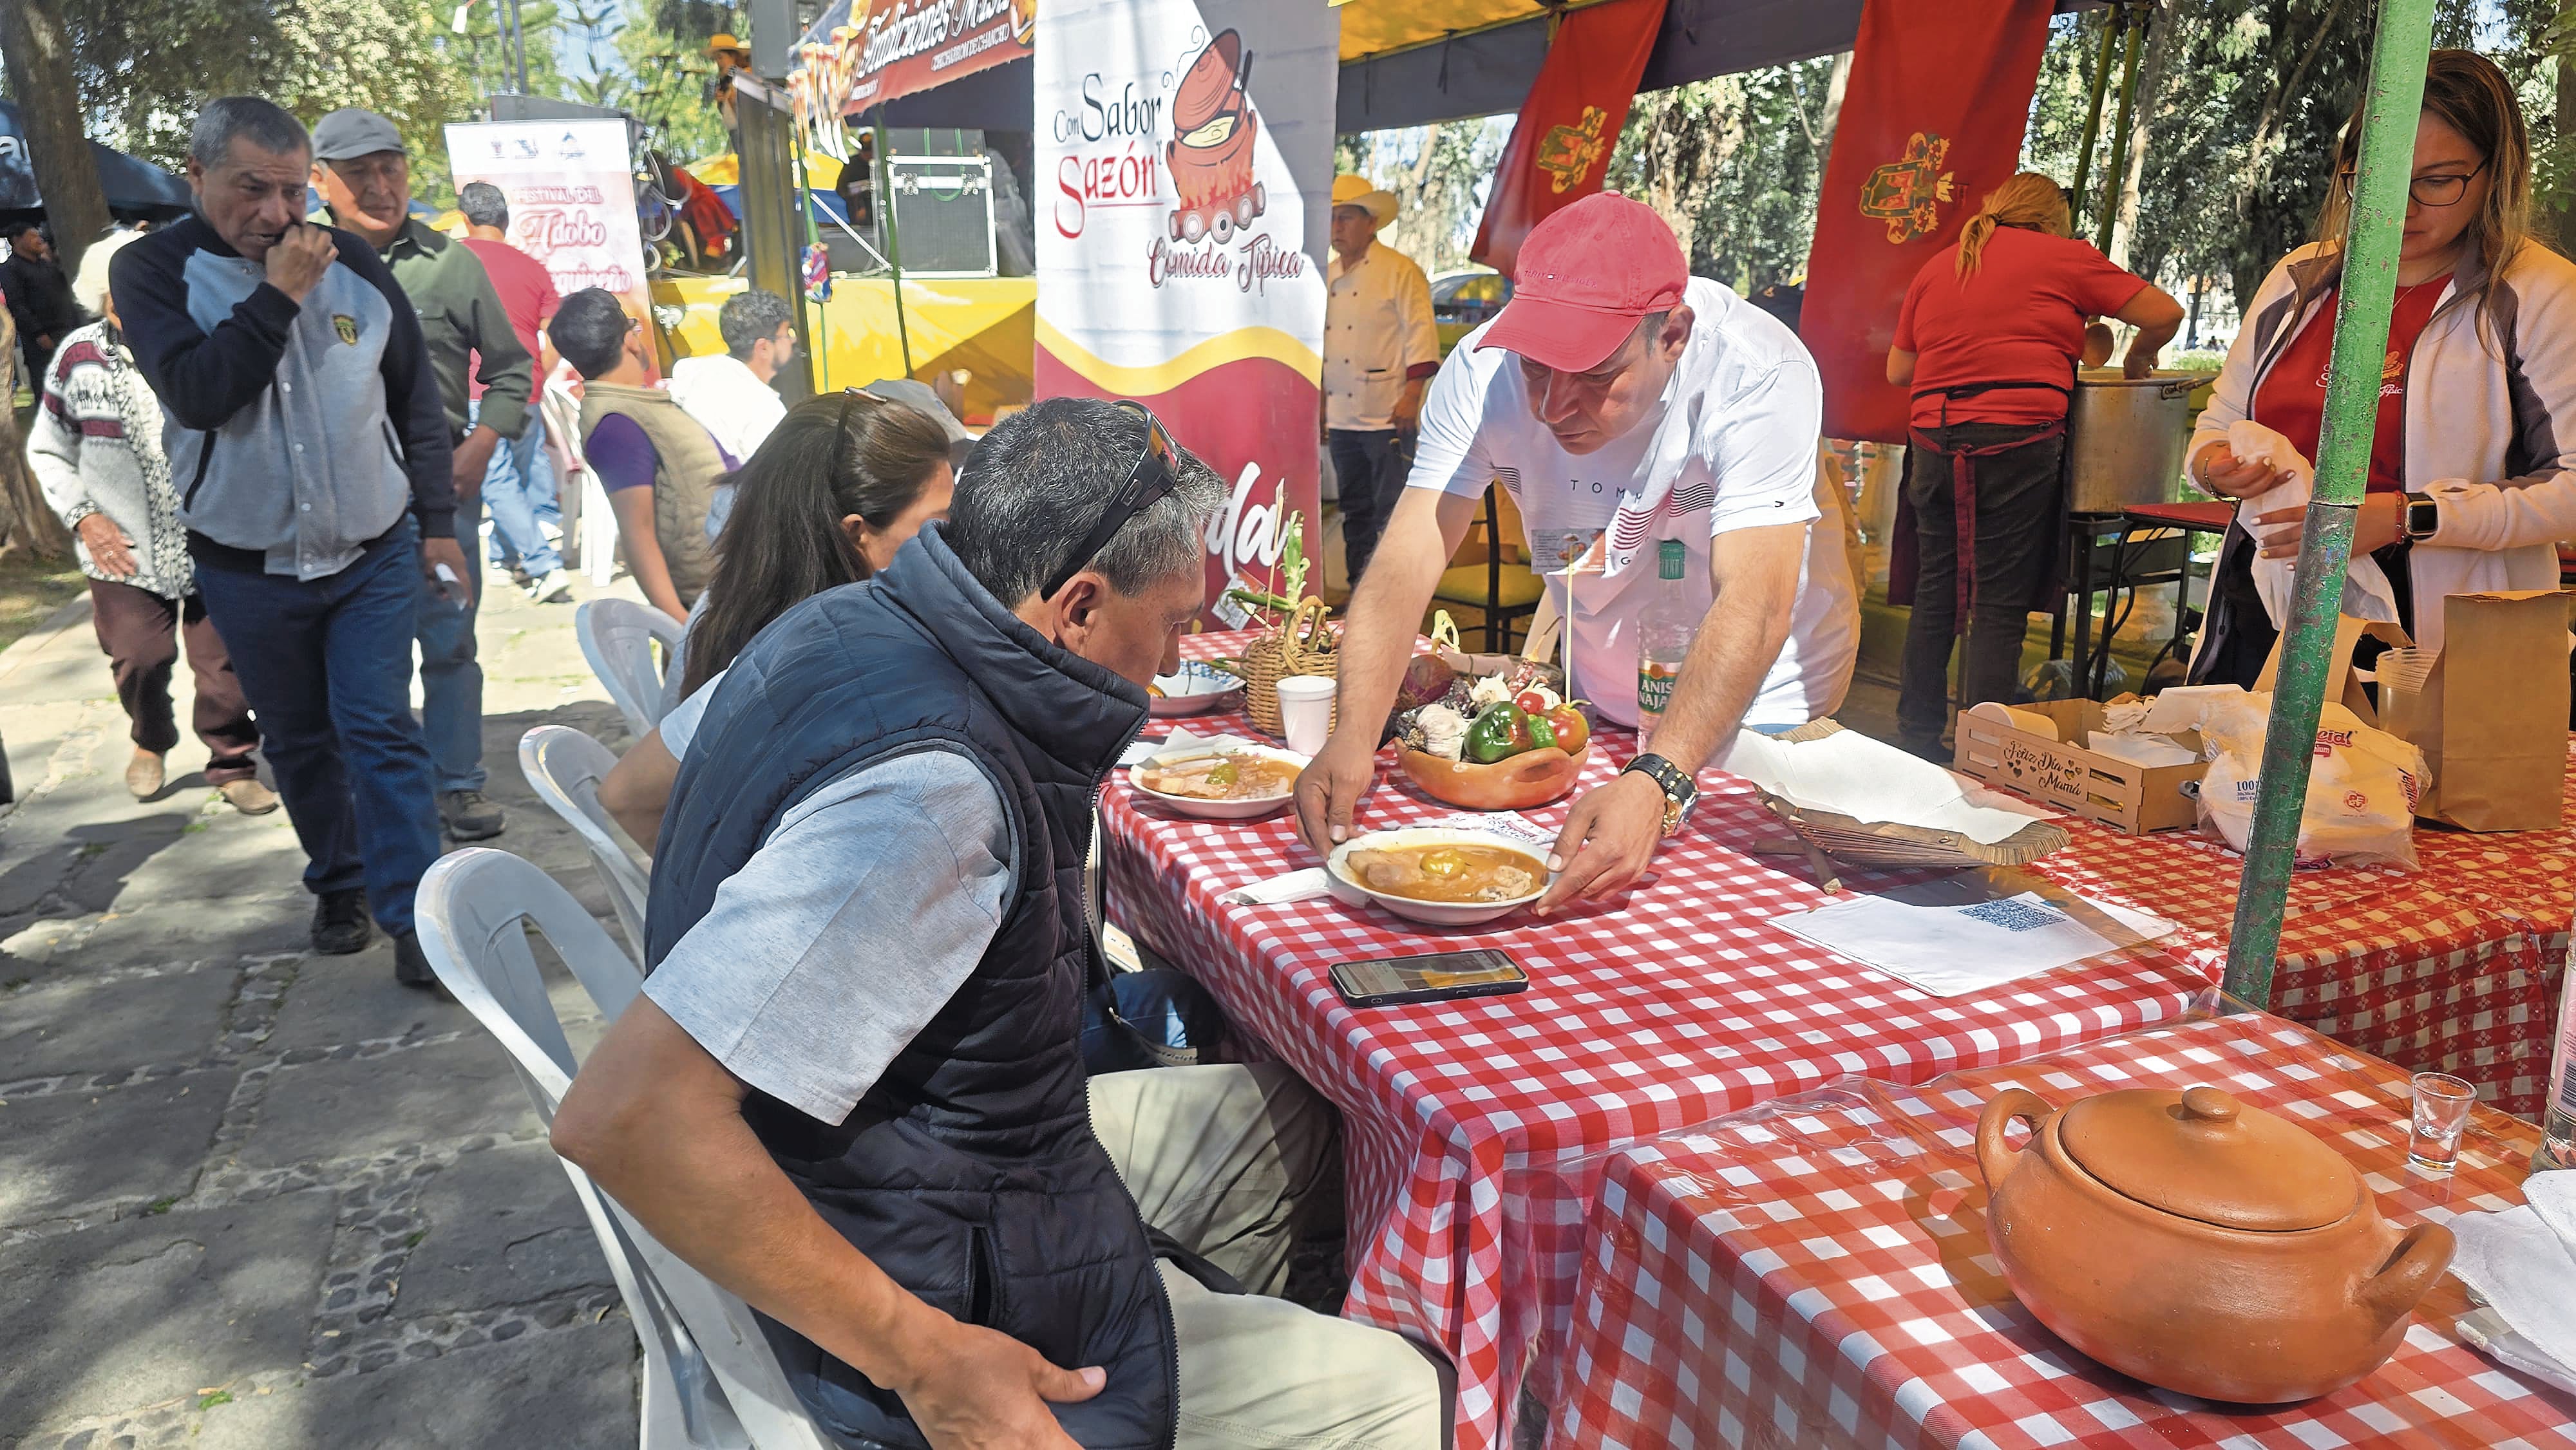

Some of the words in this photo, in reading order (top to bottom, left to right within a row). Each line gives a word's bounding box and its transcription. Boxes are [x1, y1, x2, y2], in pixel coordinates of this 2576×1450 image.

[1054, 109, 1079, 143] Con
[1081, 73, 1161, 142] Sabor
[575, 185, 605, 205] DEL
[1054, 140, 1158, 239] Sazón
[515, 207, 607, 256] Adobo
[1147, 236, 1233, 288] Comida
[2379, 384, 2403, 397] Tipic
[1642, 679, 1674, 694] ANIS
[1638, 690, 1670, 710] NAJA
[2038, 751, 2063, 771] Día
[2038, 771, 2081, 795] Mamá
